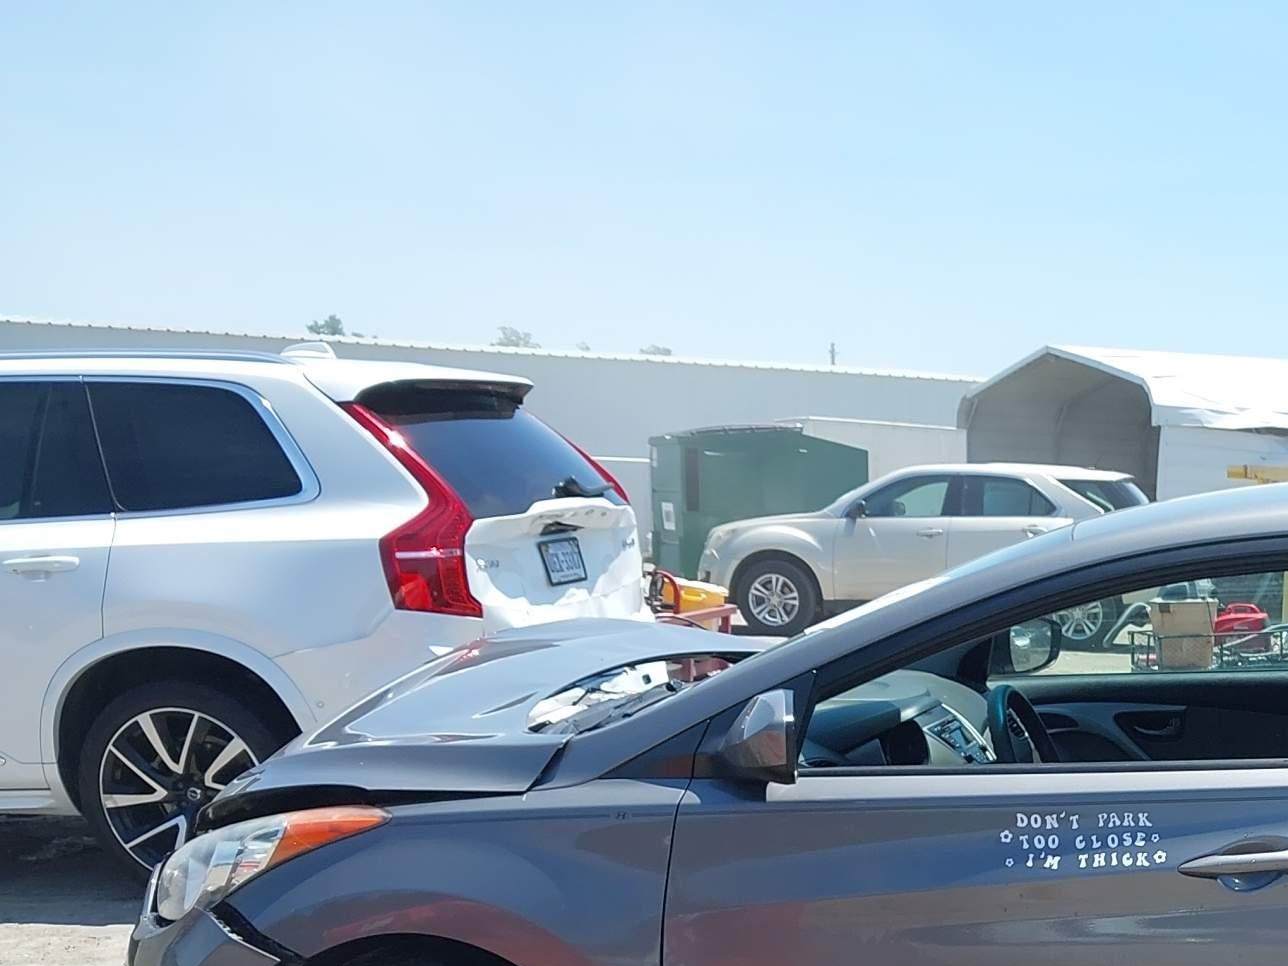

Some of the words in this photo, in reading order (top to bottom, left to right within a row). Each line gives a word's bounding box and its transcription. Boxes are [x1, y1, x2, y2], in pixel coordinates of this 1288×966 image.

[1016, 811, 1080, 830] DON'T
[1097, 812, 1153, 828] PARK
[1019, 834, 1060, 849] TOO
[1075, 832, 1146, 849] CLOSE
[1026, 851, 1061, 870] I'M
[1078, 852, 1150, 868] THICK
